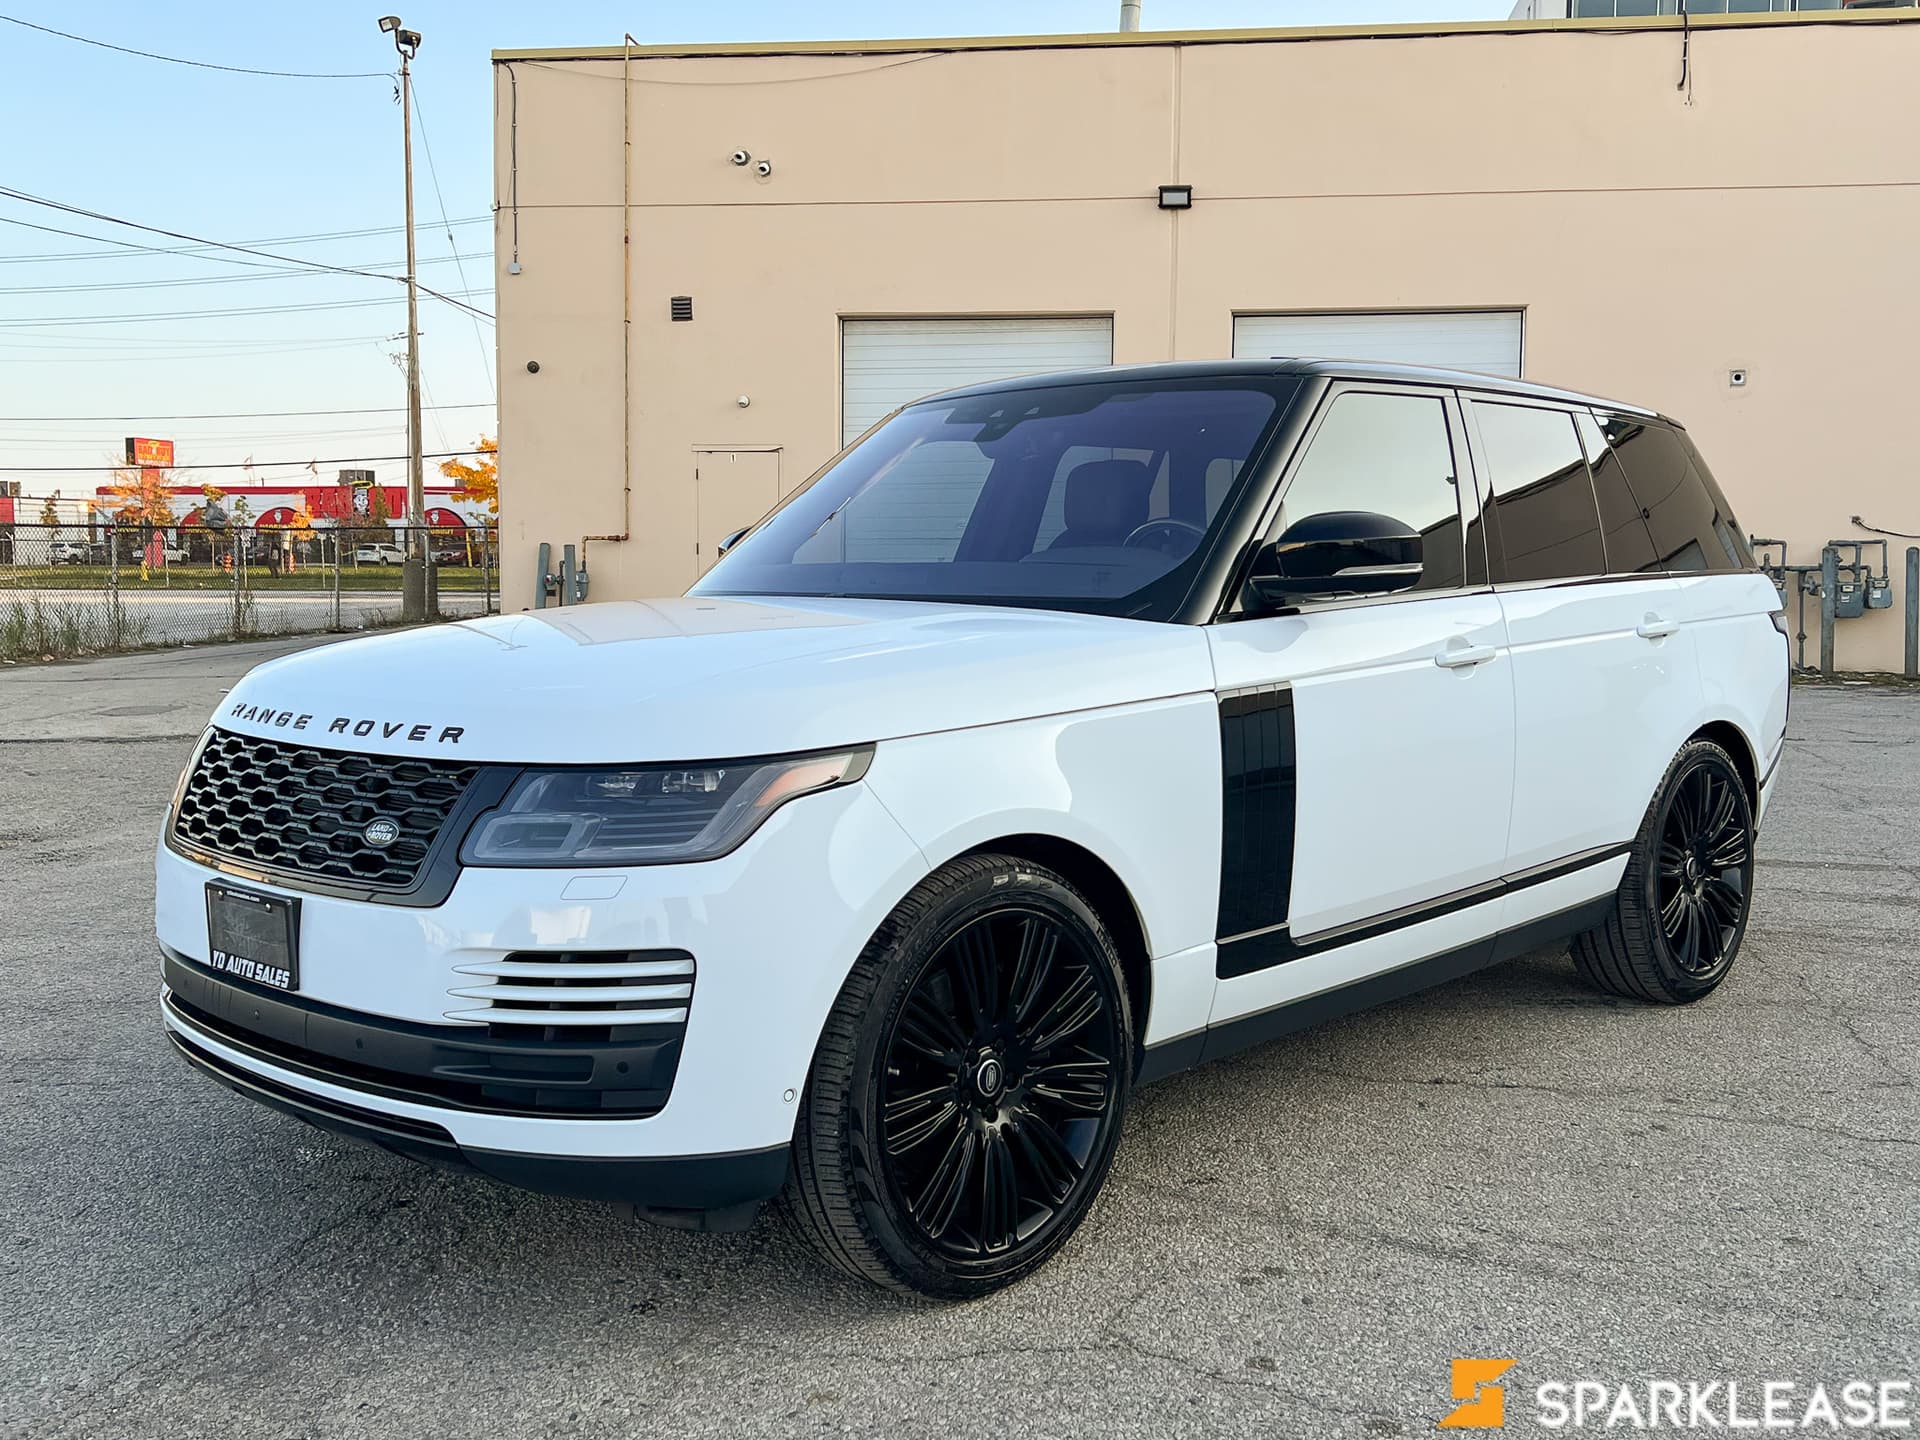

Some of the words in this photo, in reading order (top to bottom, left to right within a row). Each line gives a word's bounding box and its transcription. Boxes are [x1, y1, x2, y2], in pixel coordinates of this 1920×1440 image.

[231, 702, 313, 730] RANGE
[328, 717, 464, 743] ROVER
[370, 831, 393, 841] ROVER
[371, 823, 391, 831] LAND
[226, 955, 256, 979] AUTO
[254, 963, 290, 989] SALES
